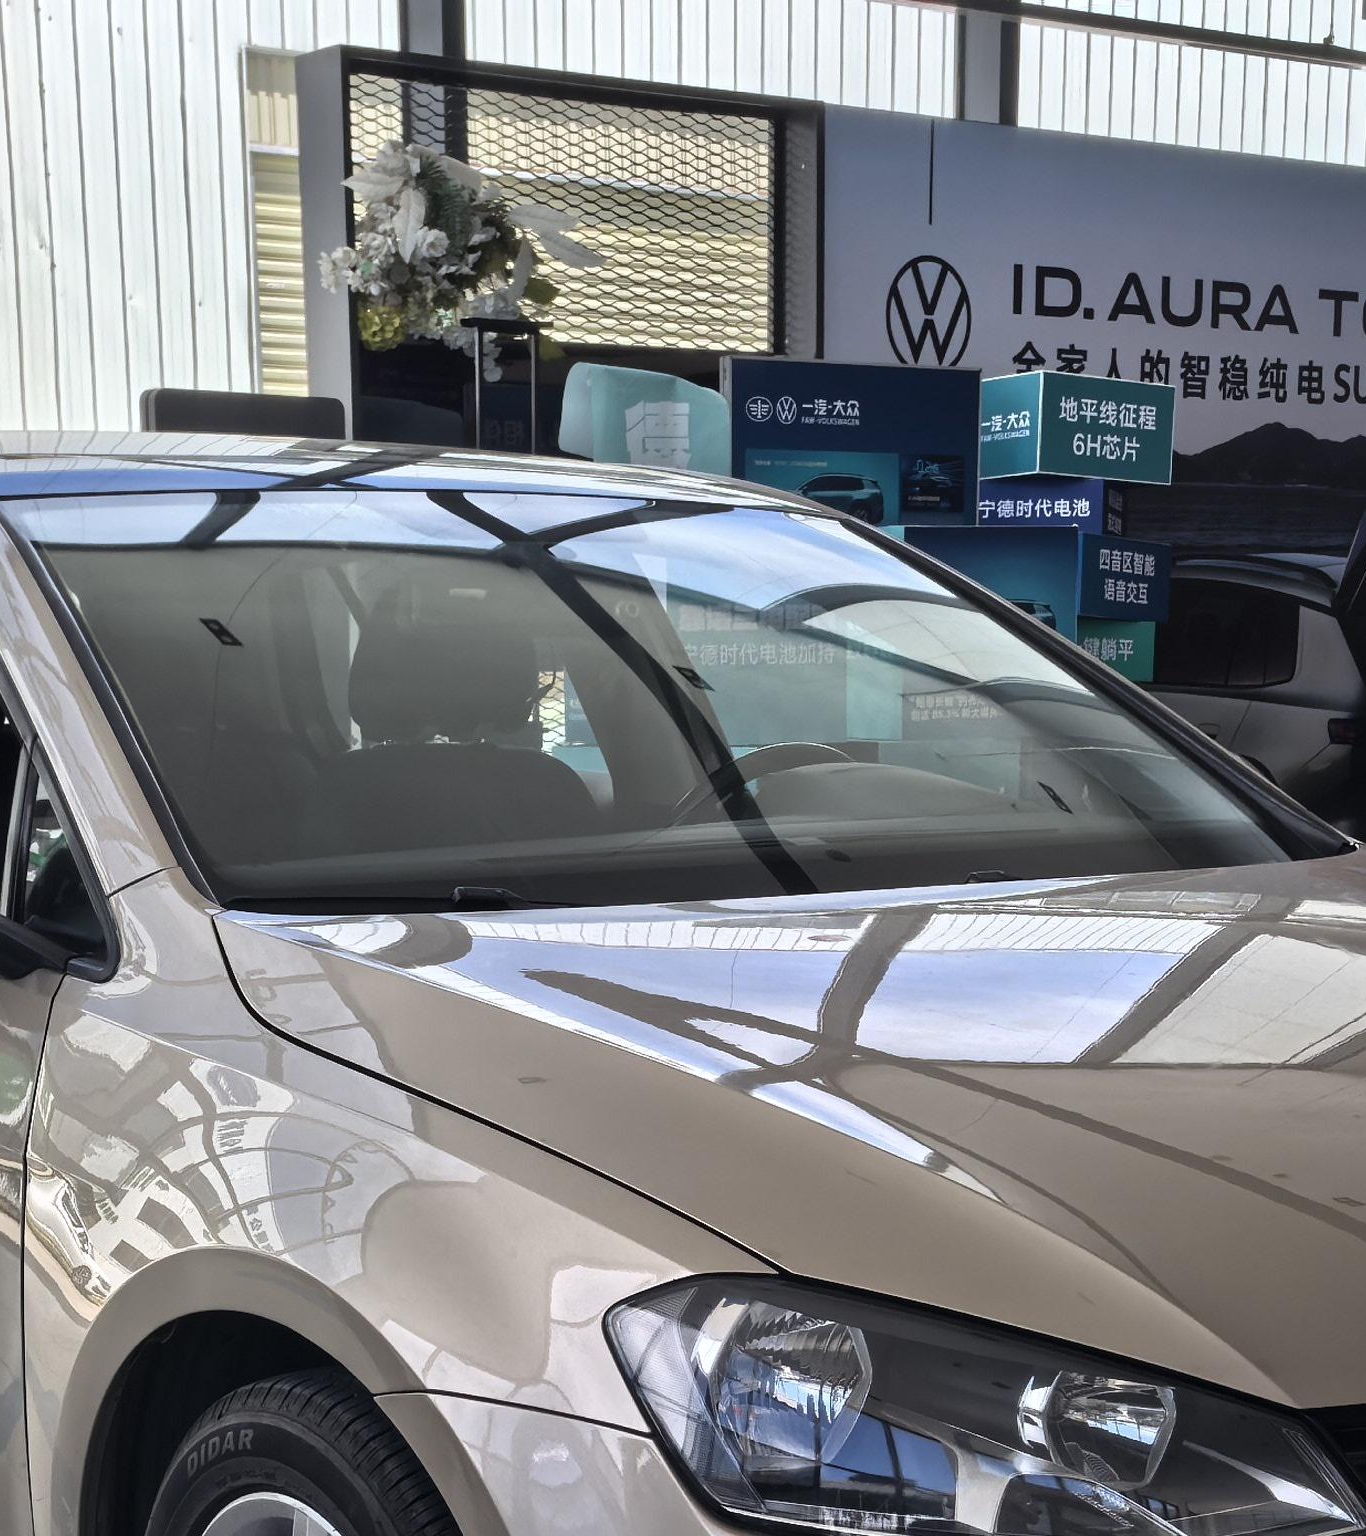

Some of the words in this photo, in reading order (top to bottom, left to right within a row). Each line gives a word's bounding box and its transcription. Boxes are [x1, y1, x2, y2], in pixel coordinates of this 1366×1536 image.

[1059, 396, 1157, 431] 地平线征程
[1072, 432, 1141, 462] 6H芯片
[978, 498, 1091, 519] 宁德时代电池
[1099, 548, 1156, 577] 四音区智能
[1104, 578, 1149, 605] 语音交互
